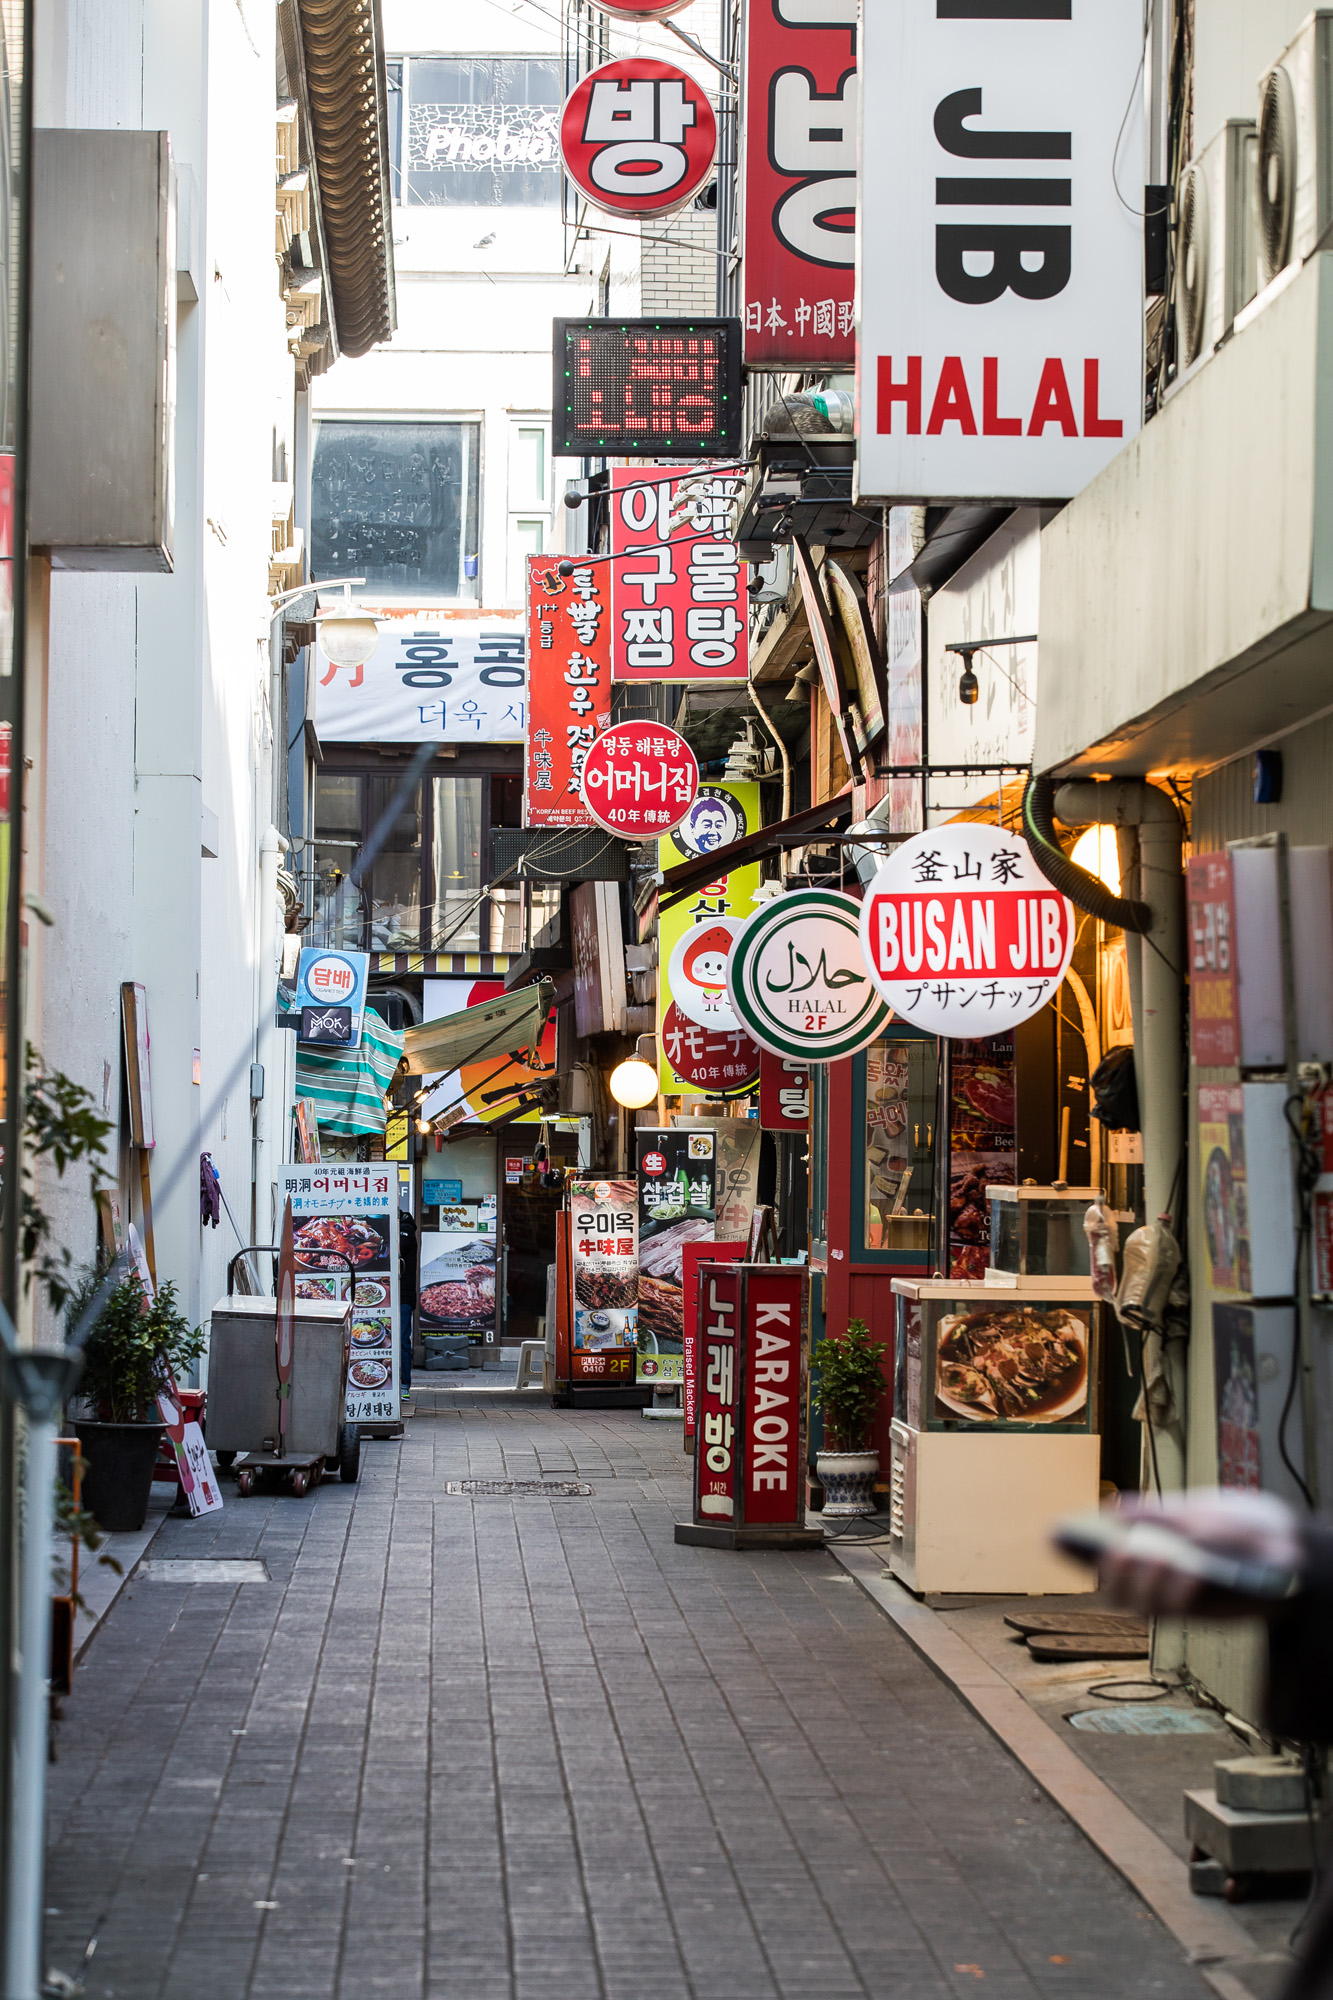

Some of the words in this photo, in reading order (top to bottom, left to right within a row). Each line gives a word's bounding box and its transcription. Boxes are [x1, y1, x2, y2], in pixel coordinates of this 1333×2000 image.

[581, 79, 697, 197] 방
[933, 86, 1072, 305] JIB
[877, 355, 1124, 438] HALAL
[620, 480, 678, 668] 아구찜
[539, 621, 554, 649] 등급
[417, 699, 487, 731] 더욱
[533, 728, 553, 791] 牛味屋
[602, 736, 633, 757] 명동
[636, 736, 682, 758] 해물탕
[587, 760, 693, 802] 어머니집
[911, 849, 1024, 885] 釜山家
[878, 899, 996, 972] BUSAN
[1009, 898, 1063, 969] JIB
[314, 967, 351, 989] 담배
[766, 940, 867, 993] حلال
[788, 999, 847, 1014] HALAL
[905, 979, 1050, 1012] プサンチップ
[691, 1066, 720, 1081] 40年
[645, 1153, 663, 1171] 生
[641, 1181, 710, 1205] 삼겹살
[577, 1212, 634, 1235] 우미옥
[578, 1238, 634, 1257] 牛味屋
[609, 1359, 630, 1373] 2F
[685, 1337, 694, 1376] Braised
[705, 1279, 735, 1473] 노래방
[686, 1378, 695, 1425] Mackerel
[753, 1303, 791, 1492] KARAOKE
